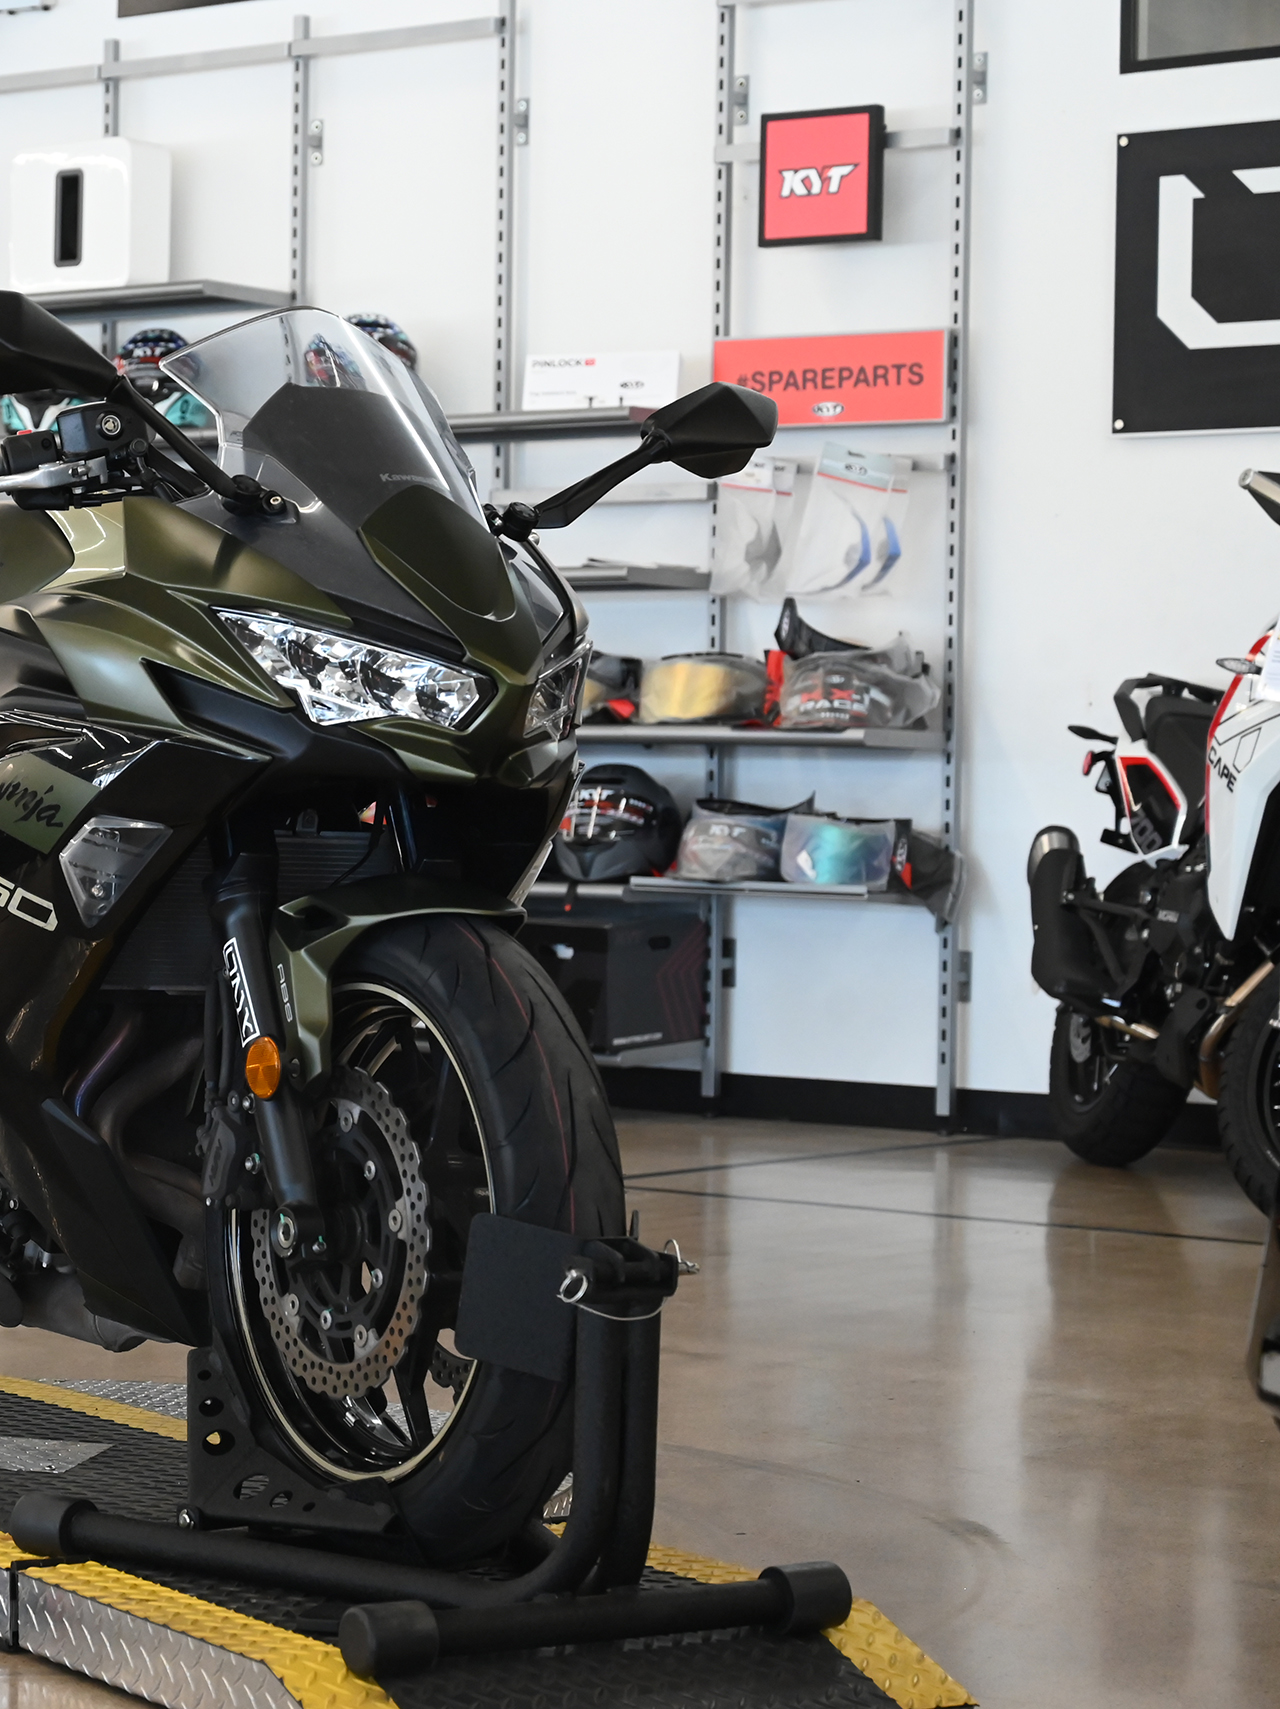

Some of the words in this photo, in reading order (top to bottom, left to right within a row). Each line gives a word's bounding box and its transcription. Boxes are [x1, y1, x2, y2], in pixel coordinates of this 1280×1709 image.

[778, 162, 860, 198] KYT
[737, 362, 925, 393] #SPAREPARTS
[277, 963, 293, 1022] ABS
